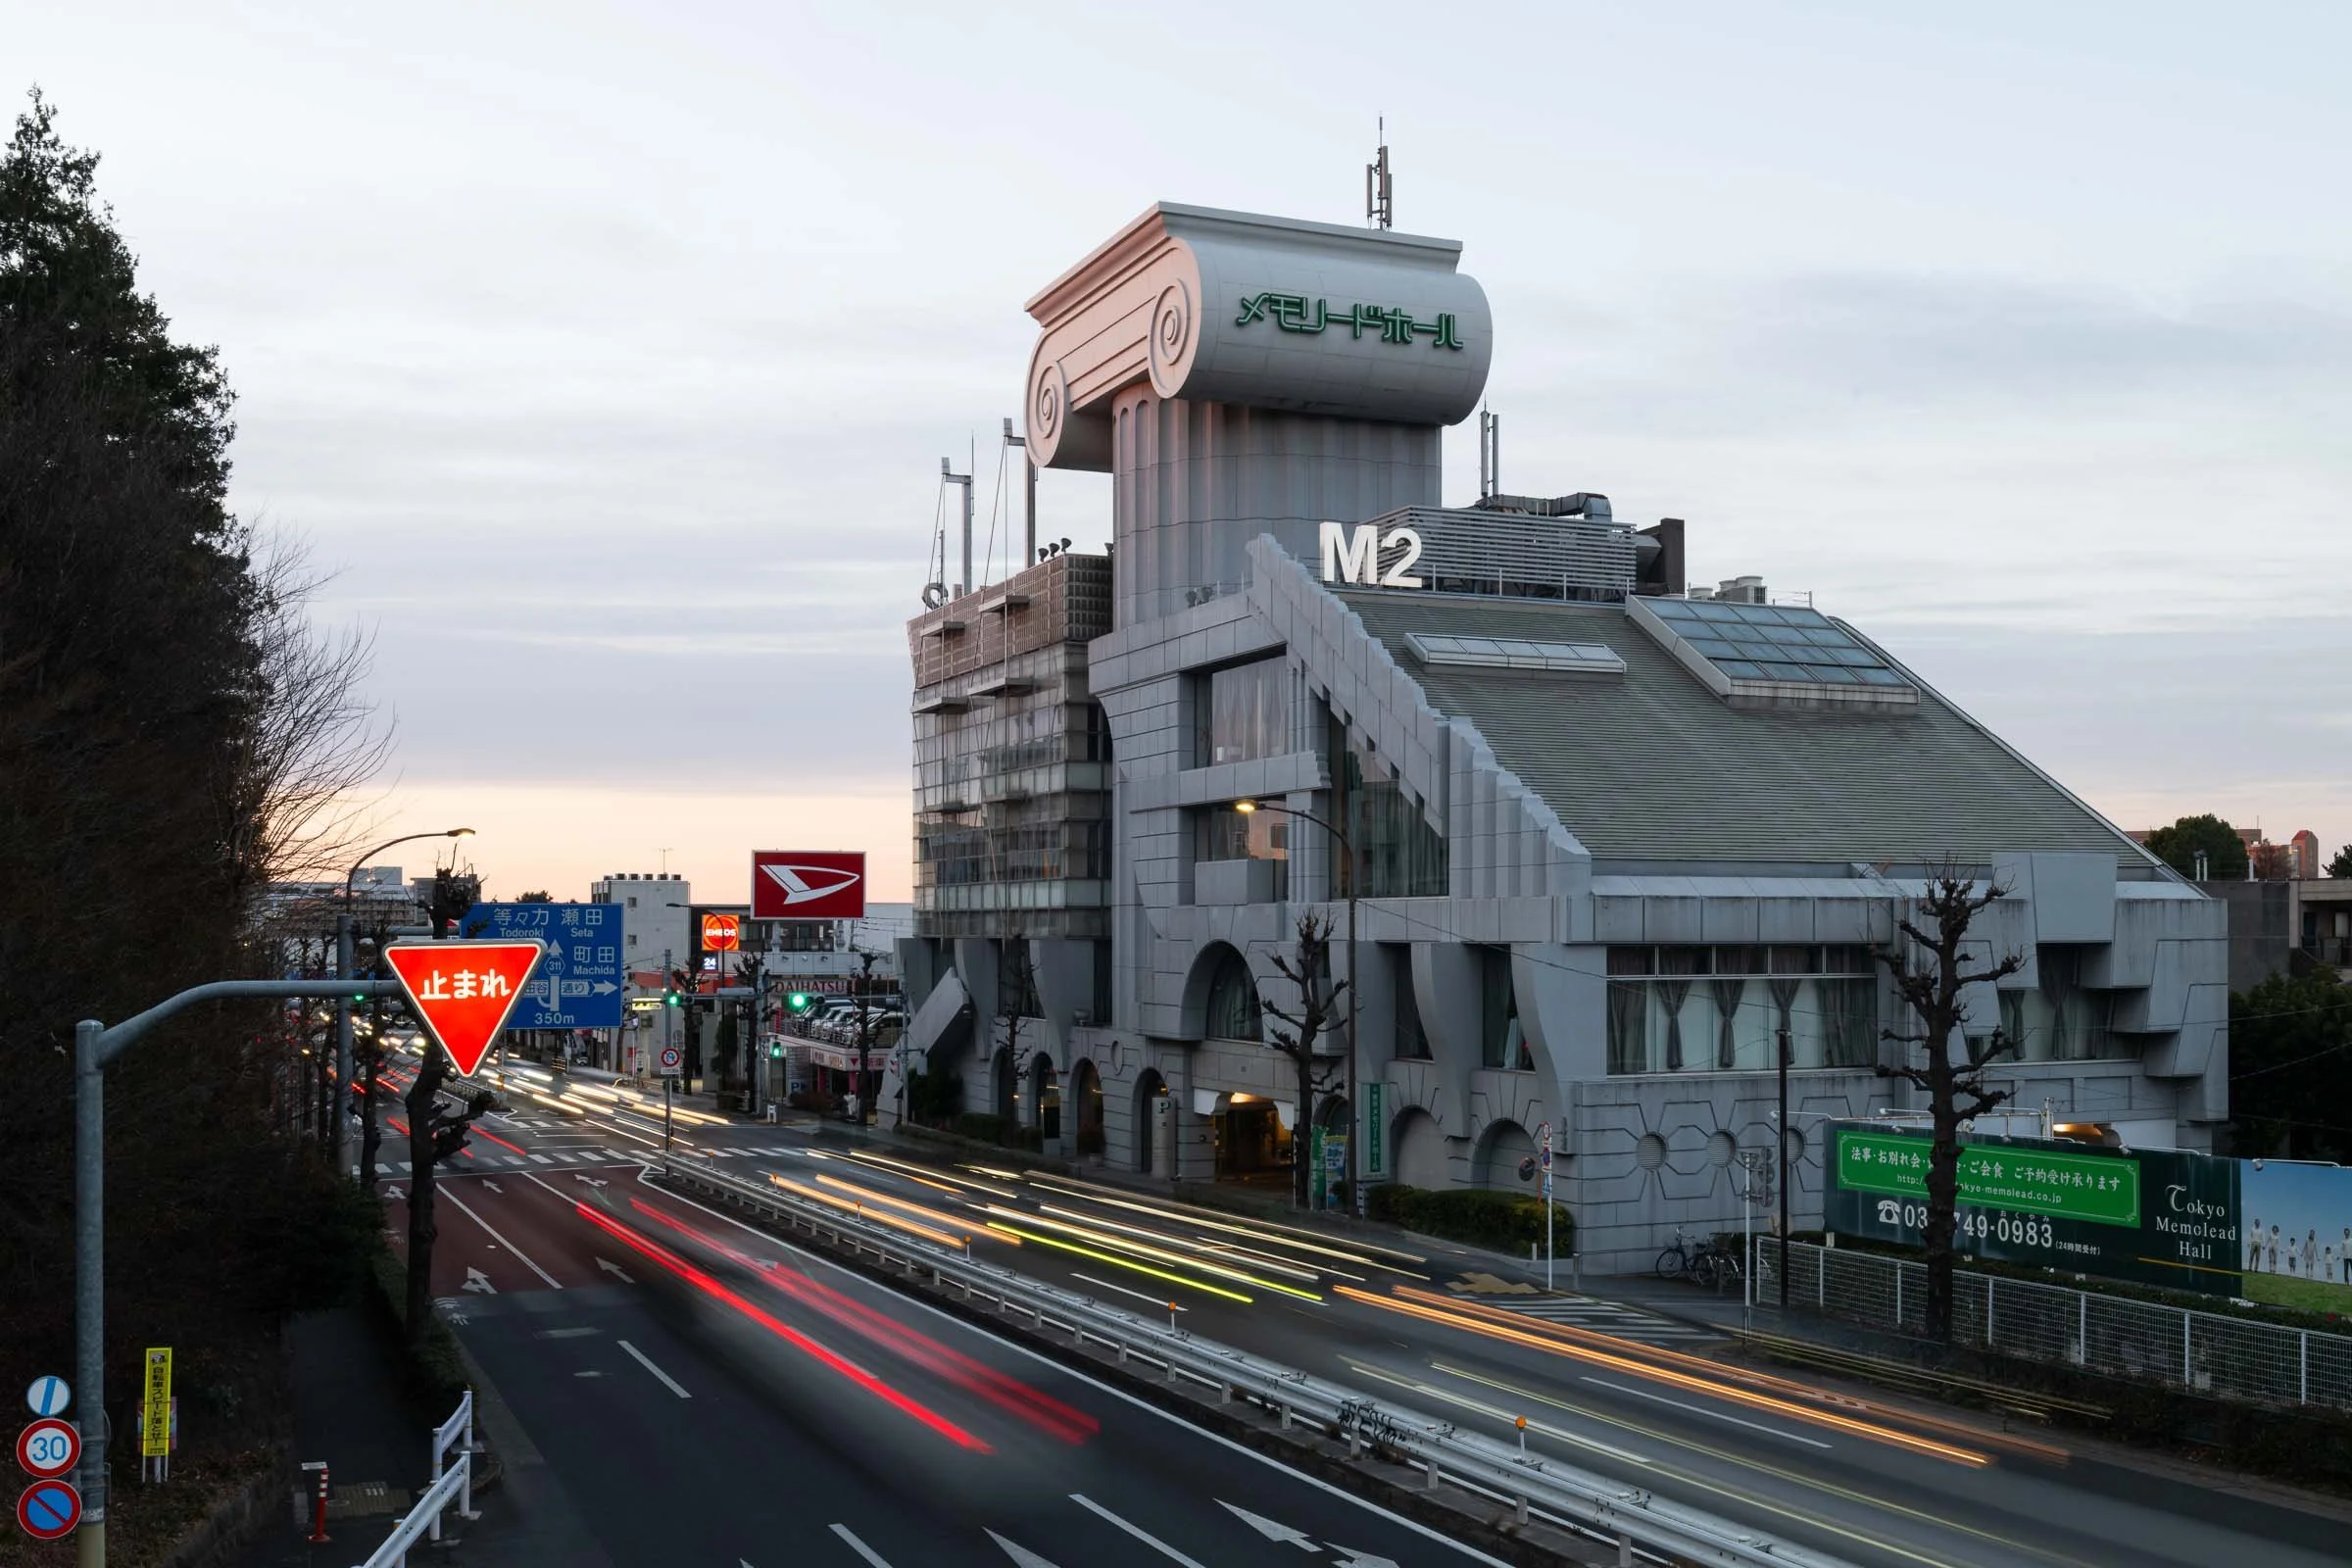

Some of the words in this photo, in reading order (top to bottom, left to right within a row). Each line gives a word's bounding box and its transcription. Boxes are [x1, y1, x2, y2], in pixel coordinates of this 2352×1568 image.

[1236, 292, 1464, 352] メモリードホール
[1319, 521, 1423, 588] M2
[493, 907, 550, 926] 等々力
[561, 907, 603, 926] 瀬田
[499, 927, 545, 938] Todoroki
[570, 927, 594, 938] Seta
[706, 928, 736, 937] ENEOS
[573, 946, 615, 963] 町田
[704, 957, 716, 967] 24
[548, 960, 562, 971] 311
[573, 965, 615, 975] Machida
[418, 968, 512, 1001] 止まれ
[775, 981, 846, 993] DAIHATSU
[534, 1012, 575, 1025] 350m
[2164, 1184, 2226, 1219] Tokyo
[2156, 1215, 2236, 1241] Memolead
[2179, 1240, 2212, 1260] Hall
[31, 1436, 67, 1462] 30
